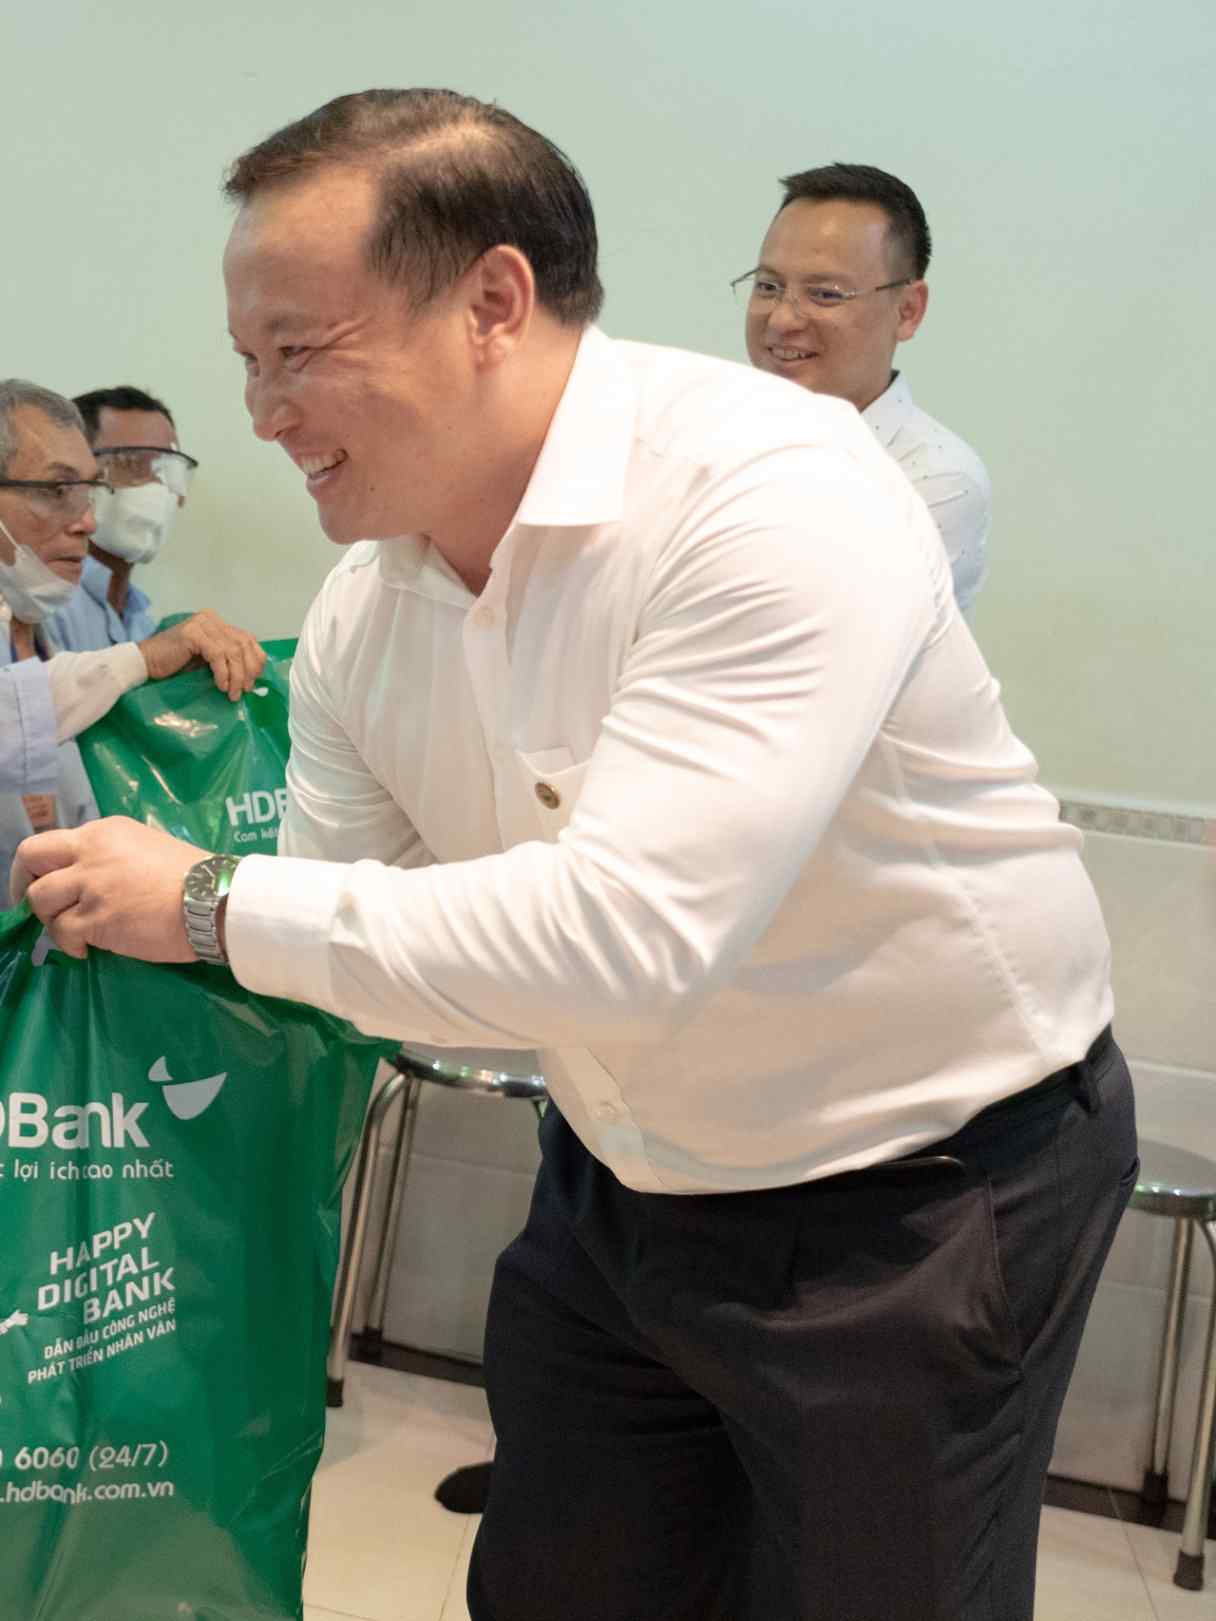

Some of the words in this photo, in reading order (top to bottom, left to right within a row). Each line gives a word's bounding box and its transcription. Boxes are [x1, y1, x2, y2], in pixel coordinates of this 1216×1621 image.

[225, 789, 288, 826] HDB
[13, 1159, 38, 1182] lợi
[122, 1158, 174, 1179] nhất
[50, 1212, 156, 1275] HAPPY
[37, 1247, 160, 1311] DIGITAL
[83, 1267, 176, 1325] BANK
[102, 1314, 135, 1339] CÔNG
[138, 1297, 176, 1323] NGHỆ
[28, 1360, 65, 1384] PHÁT
[106, 1331, 144, 1358] NHÂN
[14, 1446, 80, 1470] 6060
[89, 1440, 168, 1472] (24/7)
